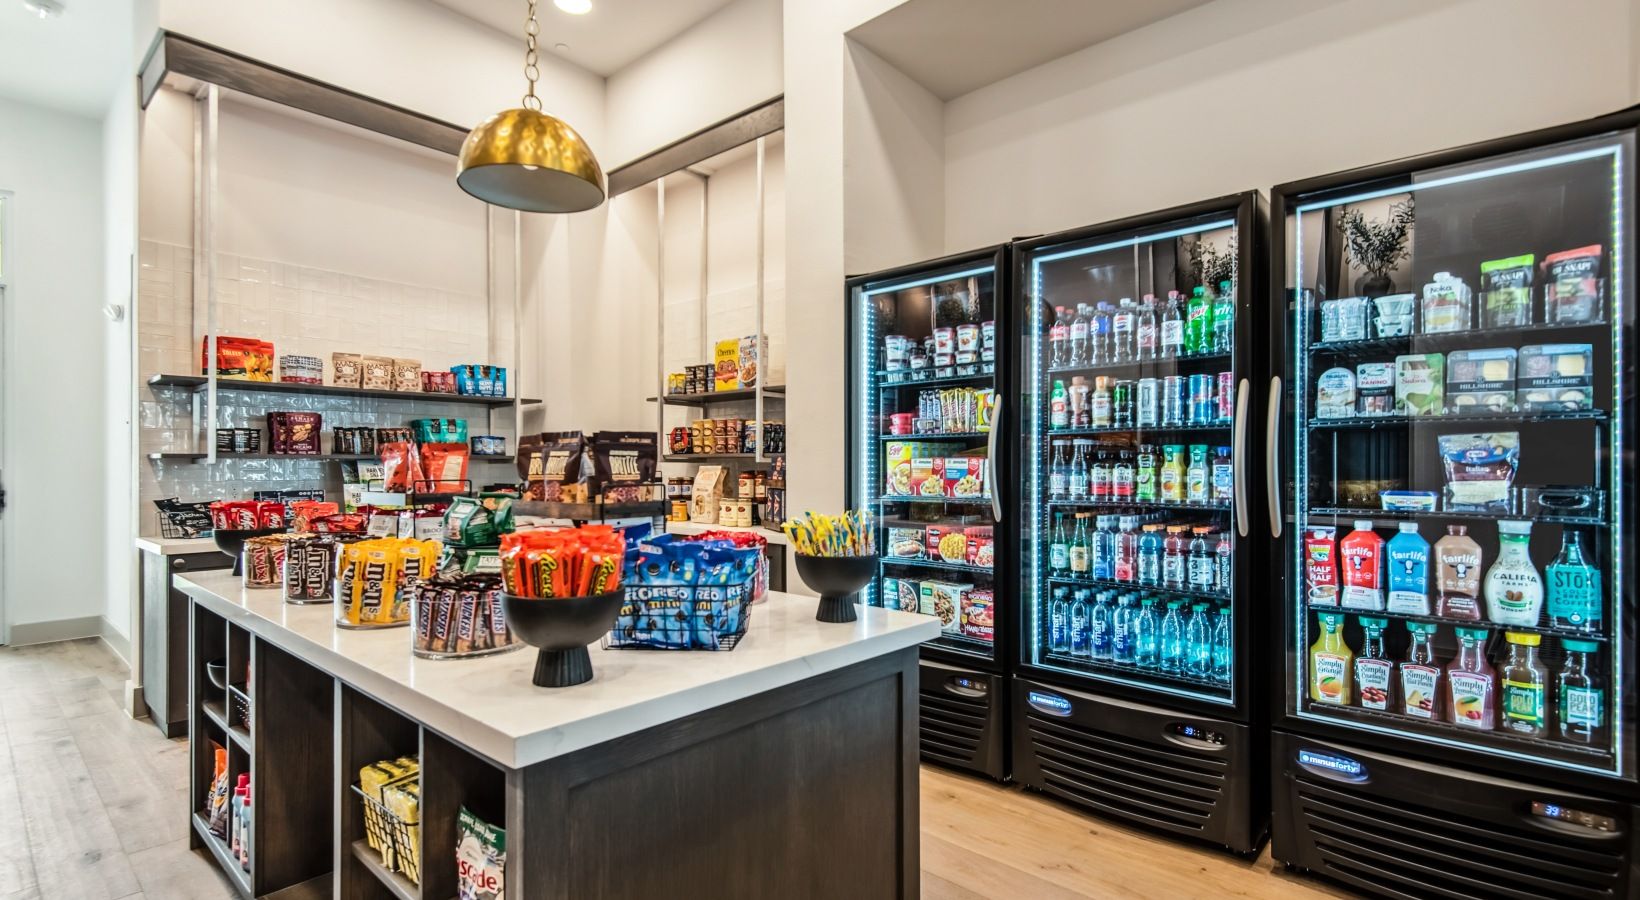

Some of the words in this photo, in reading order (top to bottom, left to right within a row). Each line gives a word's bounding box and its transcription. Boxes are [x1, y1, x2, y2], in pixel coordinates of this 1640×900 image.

[335, 360, 357, 368] MADE
[1531, 377, 1581, 386] HILLSHIRE
[1341, 546, 1373, 558] fairlife
[1391, 550, 1427, 562] fairlife
[1442, 554, 1480, 565] fairlife
[1310, 566, 1331, 574] HALF
[1310, 573, 1332, 582] HALF
[1494, 572, 1538, 583] CALIFIA
[363, 562, 385, 614] m&m's
[637, 587, 689, 600] OREO
[695, 588, 720, 600] REO
[438, 591, 452, 638] SATISFIES
[460, 594, 475, 638] SNICKERS
[1317, 658, 1342, 670] Simply
[1360, 664, 1386, 676] Simply
[1406, 669, 1433, 682] Simply
[1453, 677, 1484, 691] Simply
[1569, 693, 1596, 704] GOLD
[1569, 702, 1597, 715] PEAK
[1309, 755, 1358, 773] minusforty
[1545, 805, 1559, 817] 39
